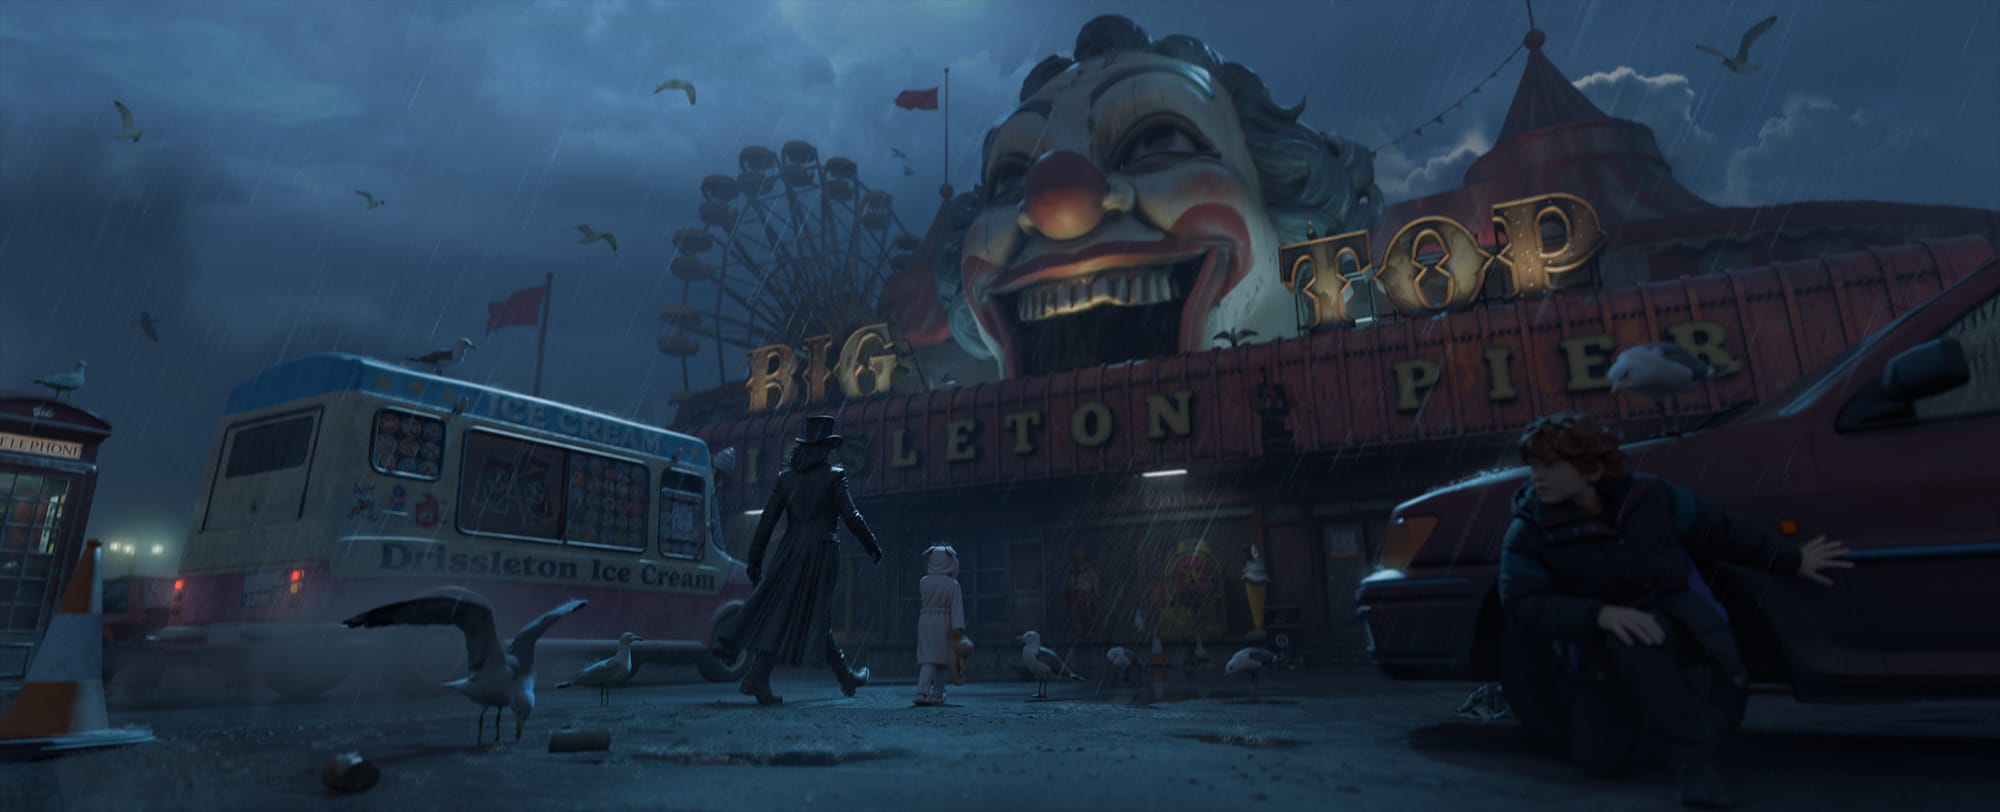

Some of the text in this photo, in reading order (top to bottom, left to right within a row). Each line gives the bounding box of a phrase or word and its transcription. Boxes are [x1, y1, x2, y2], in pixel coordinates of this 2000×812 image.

[745, 192, 1607, 412] BIG TOP
[1393, 321, 1743, 412] PIER
[486, 394, 662, 454] ICE CREAM
[379, 541, 716, 590] Drissleton Ice Cream
